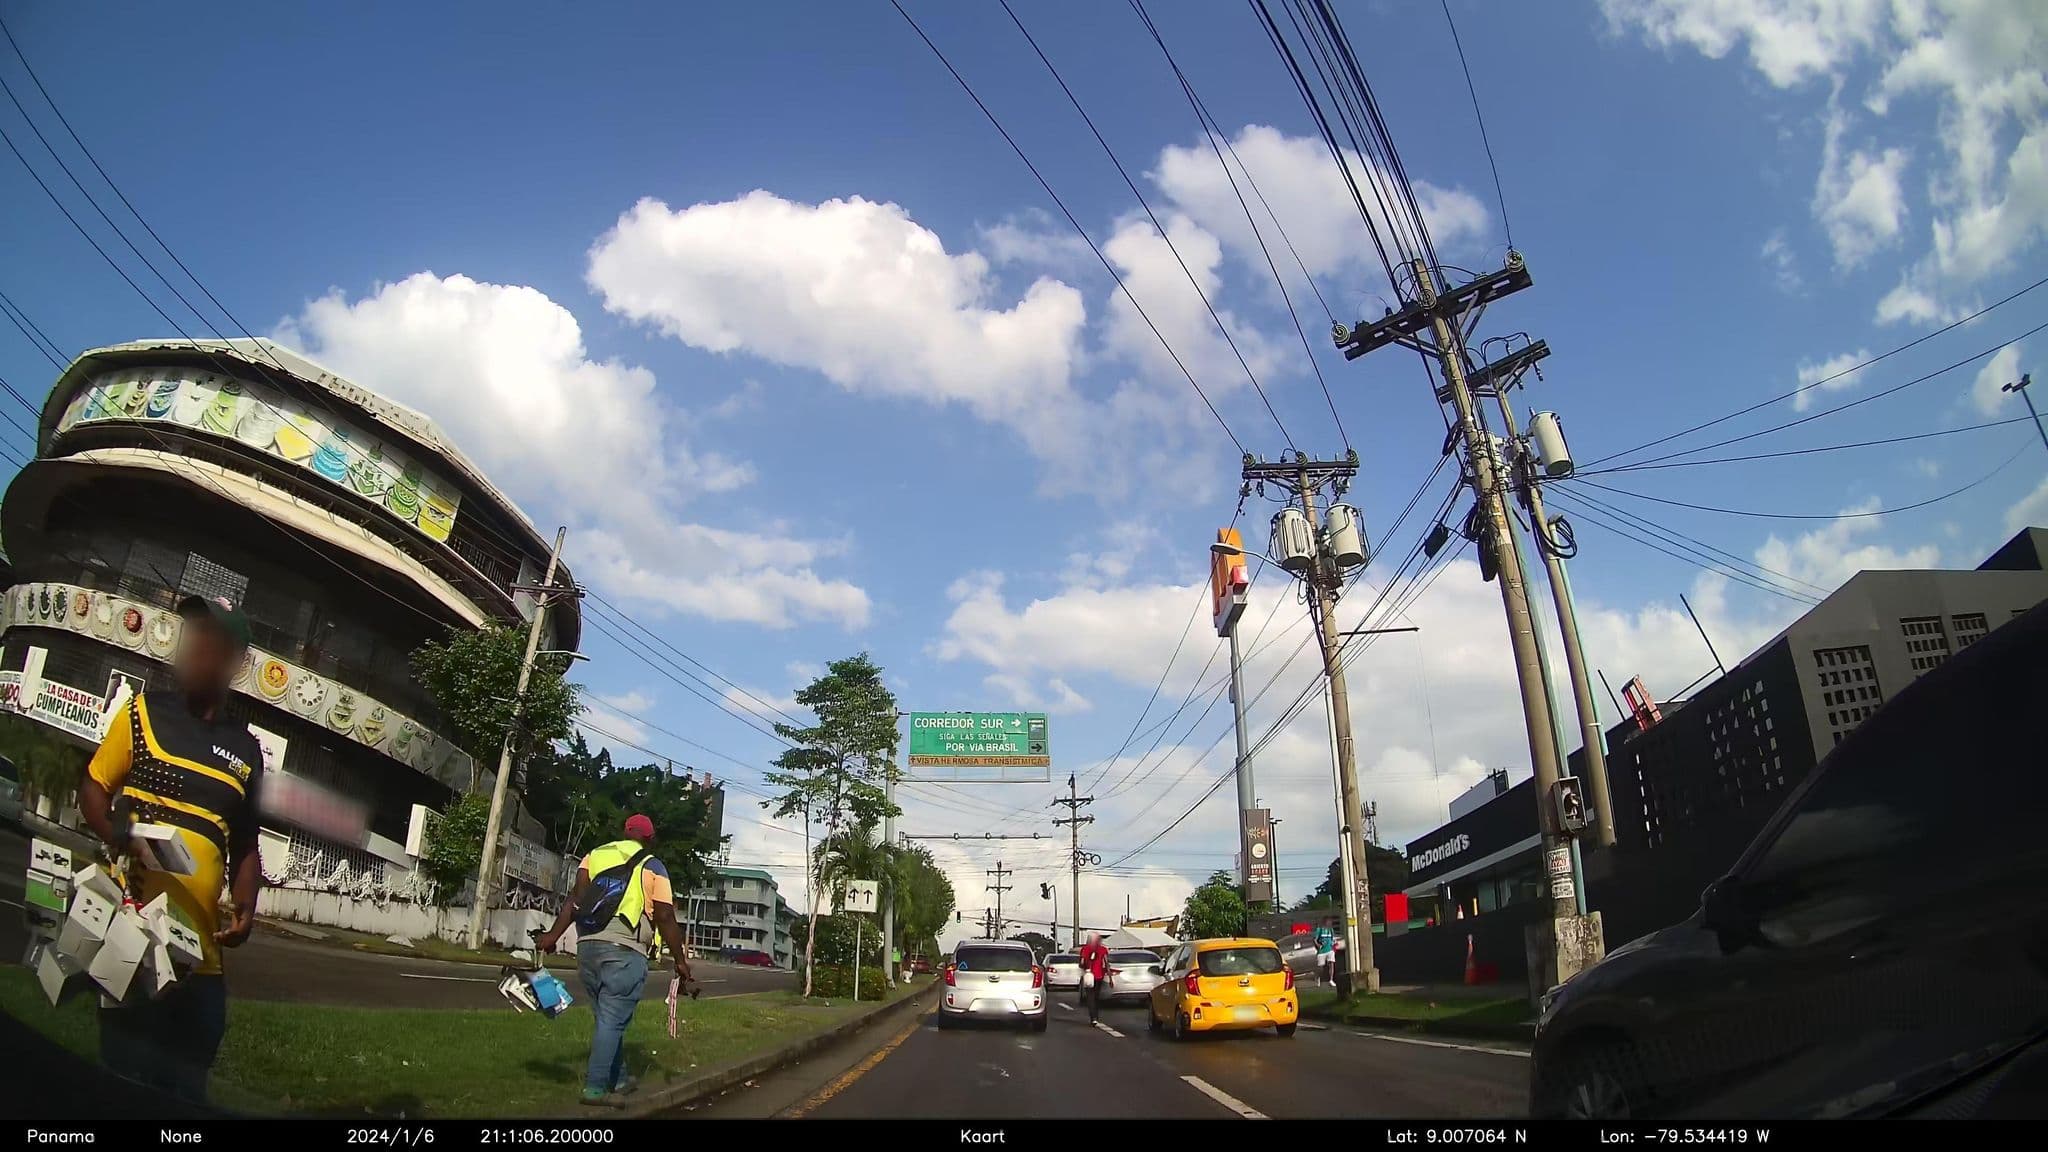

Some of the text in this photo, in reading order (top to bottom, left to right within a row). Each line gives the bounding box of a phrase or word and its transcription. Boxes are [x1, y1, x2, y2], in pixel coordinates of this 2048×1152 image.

[46, 683, 93, 708] LA CASA DE
[914, 717, 1004, 729] CORREDOR SUR
[938, 732, 955, 741] SIGA
[960, 732, 975, 741] LAS
[945, 742, 1019, 752] POR VIA BRASIL
[212, 745, 245, 767] VALUE
[916, 757, 940, 765] VISTA
[941, 757, 980, 765] HERMOSA
[1411, 833, 1470, 873] McDonald's
